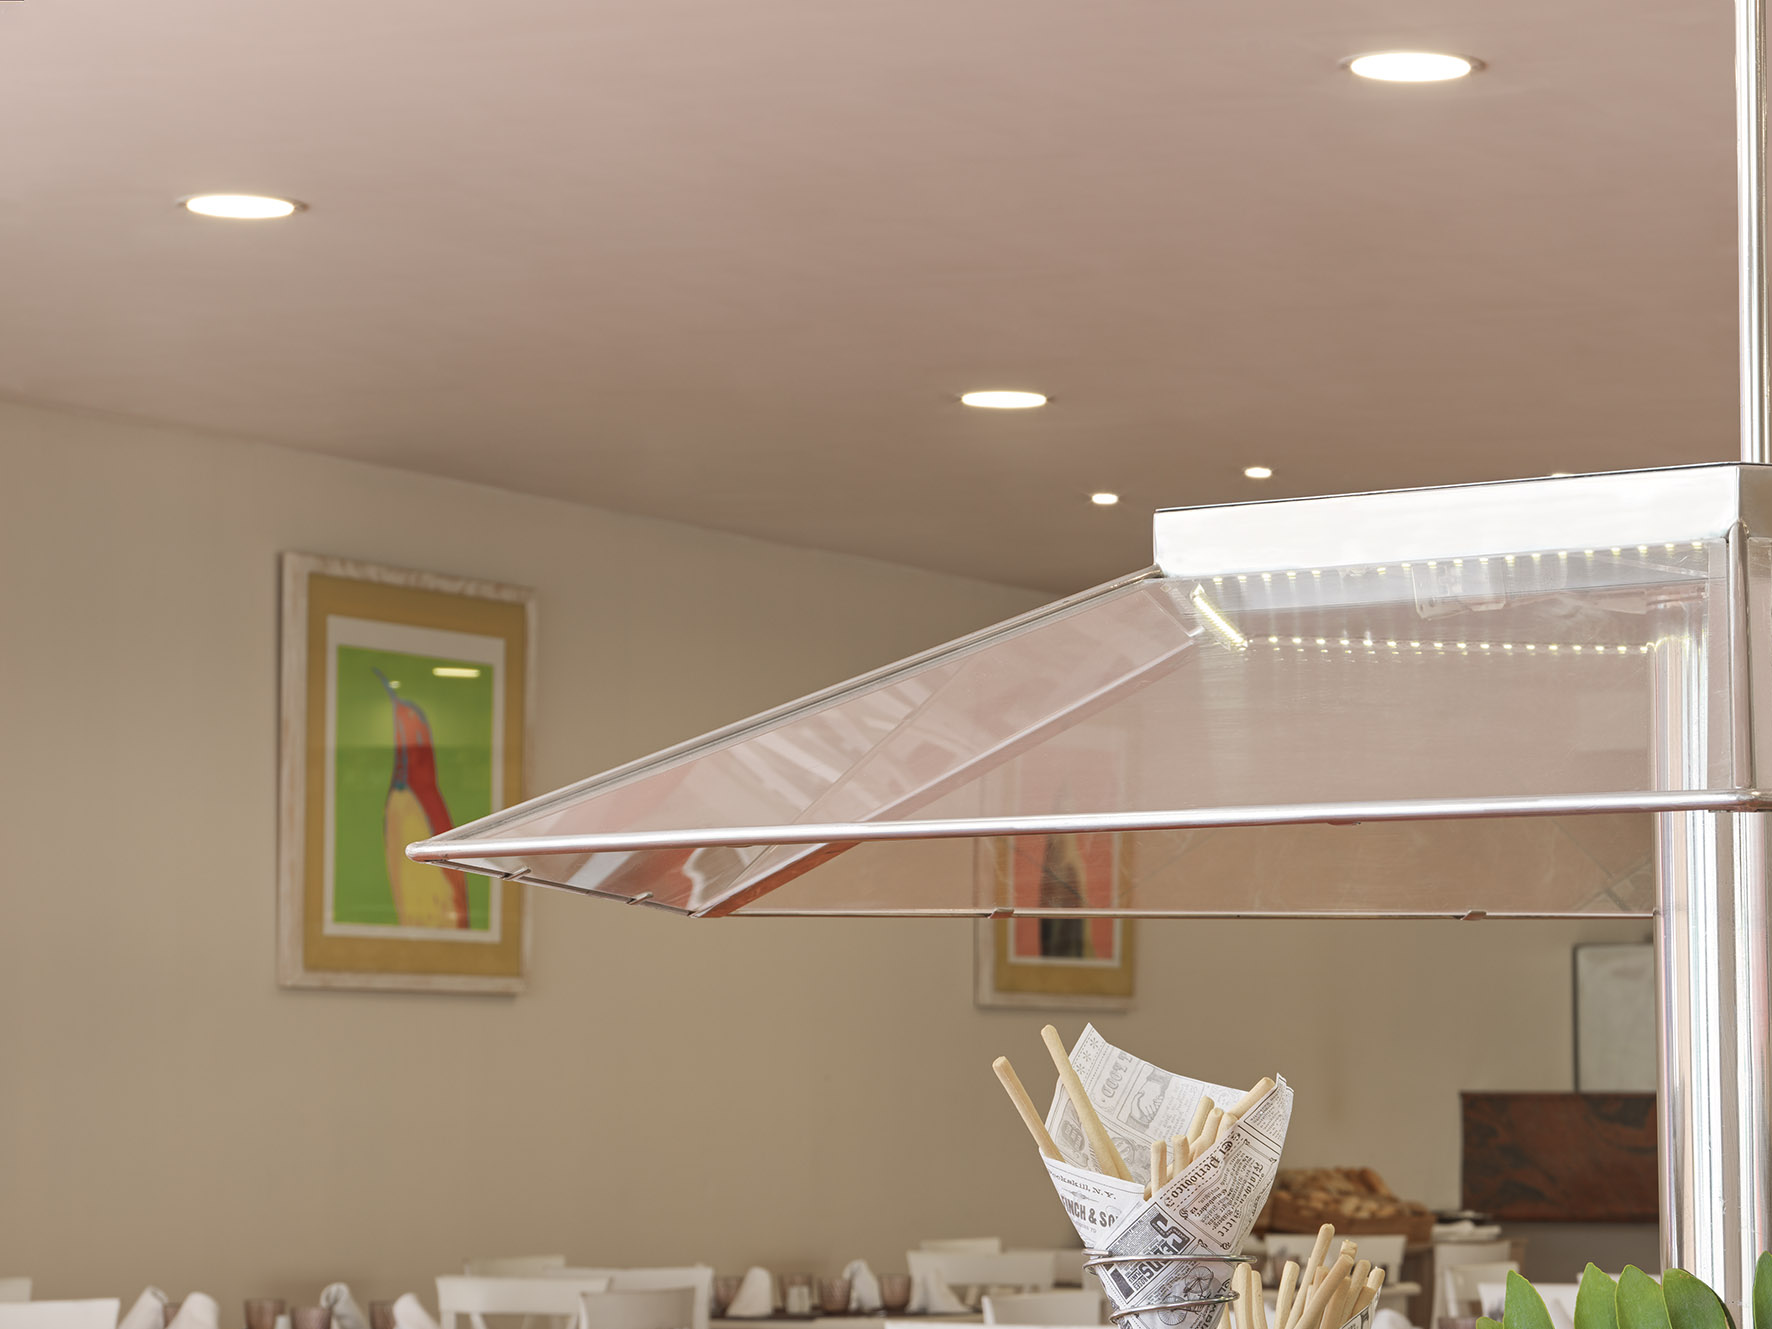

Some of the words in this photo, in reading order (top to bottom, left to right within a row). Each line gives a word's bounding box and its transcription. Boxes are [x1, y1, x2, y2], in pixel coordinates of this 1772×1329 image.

[1221, 1141, 1234, 1156] El
[1172, 1156, 1223, 1200] Periodico
[1089, 1208, 1096, 1224] &
